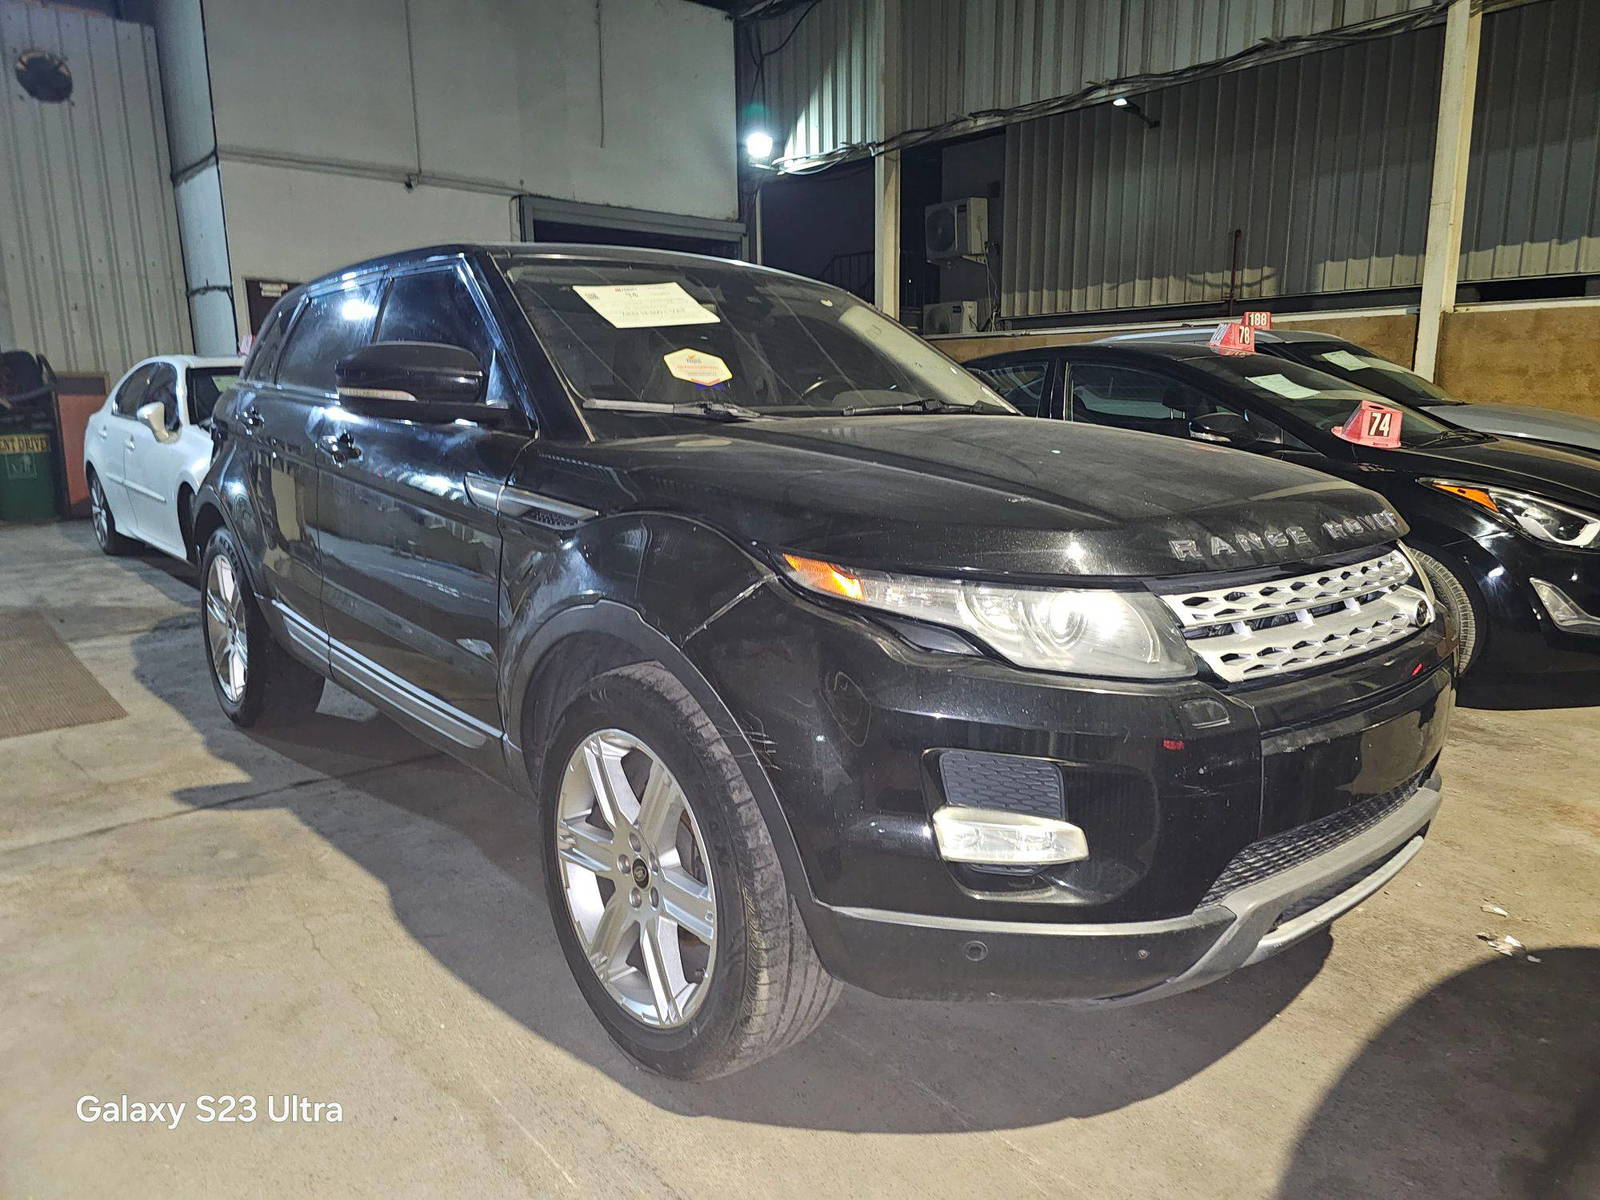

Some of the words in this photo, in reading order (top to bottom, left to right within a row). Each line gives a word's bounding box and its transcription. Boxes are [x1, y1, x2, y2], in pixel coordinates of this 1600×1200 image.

[1249, 312, 1267, 326] 188
[1239, 326, 1250, 345] 78
[1369, 412, 1391, 437] 74
[1168, 526, 1312, 561] RANGE
